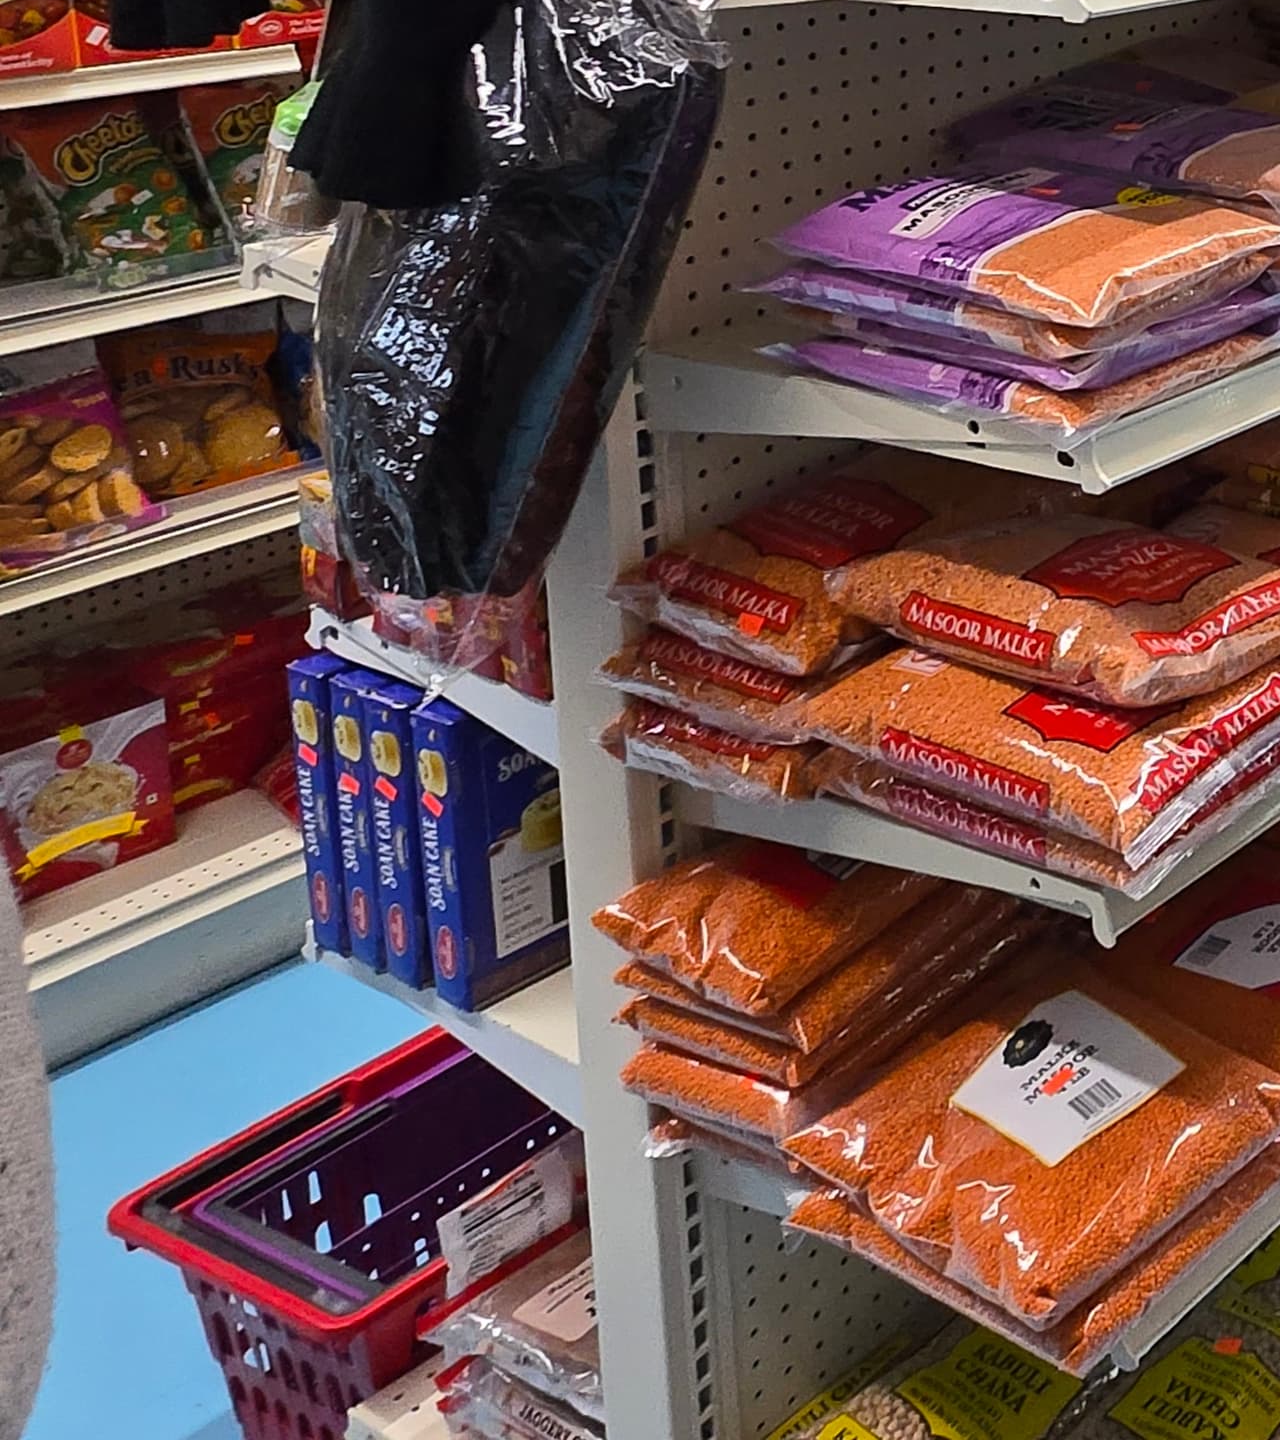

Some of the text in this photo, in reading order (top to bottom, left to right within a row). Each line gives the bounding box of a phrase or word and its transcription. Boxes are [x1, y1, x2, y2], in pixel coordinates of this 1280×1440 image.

[726, 586, 791, 625] MALKA
[905, 600, 1047, 662] MASOOR MALKA
[886, 740, 1041, 812] MASOOR MALKA
[1143, 728, 1224, 802] MASOOR
[296, 766, 321, 857] CAKE SOAN
[373, 796, 398, 890] CAKE SOAN
[972, 819, 1037, 857] MALKA
[340, 824, 360, 873] SOAN
[421, 816, 447, 912] CAKE SOAN
[1025, 1044, 1099, 1106] MOOR
